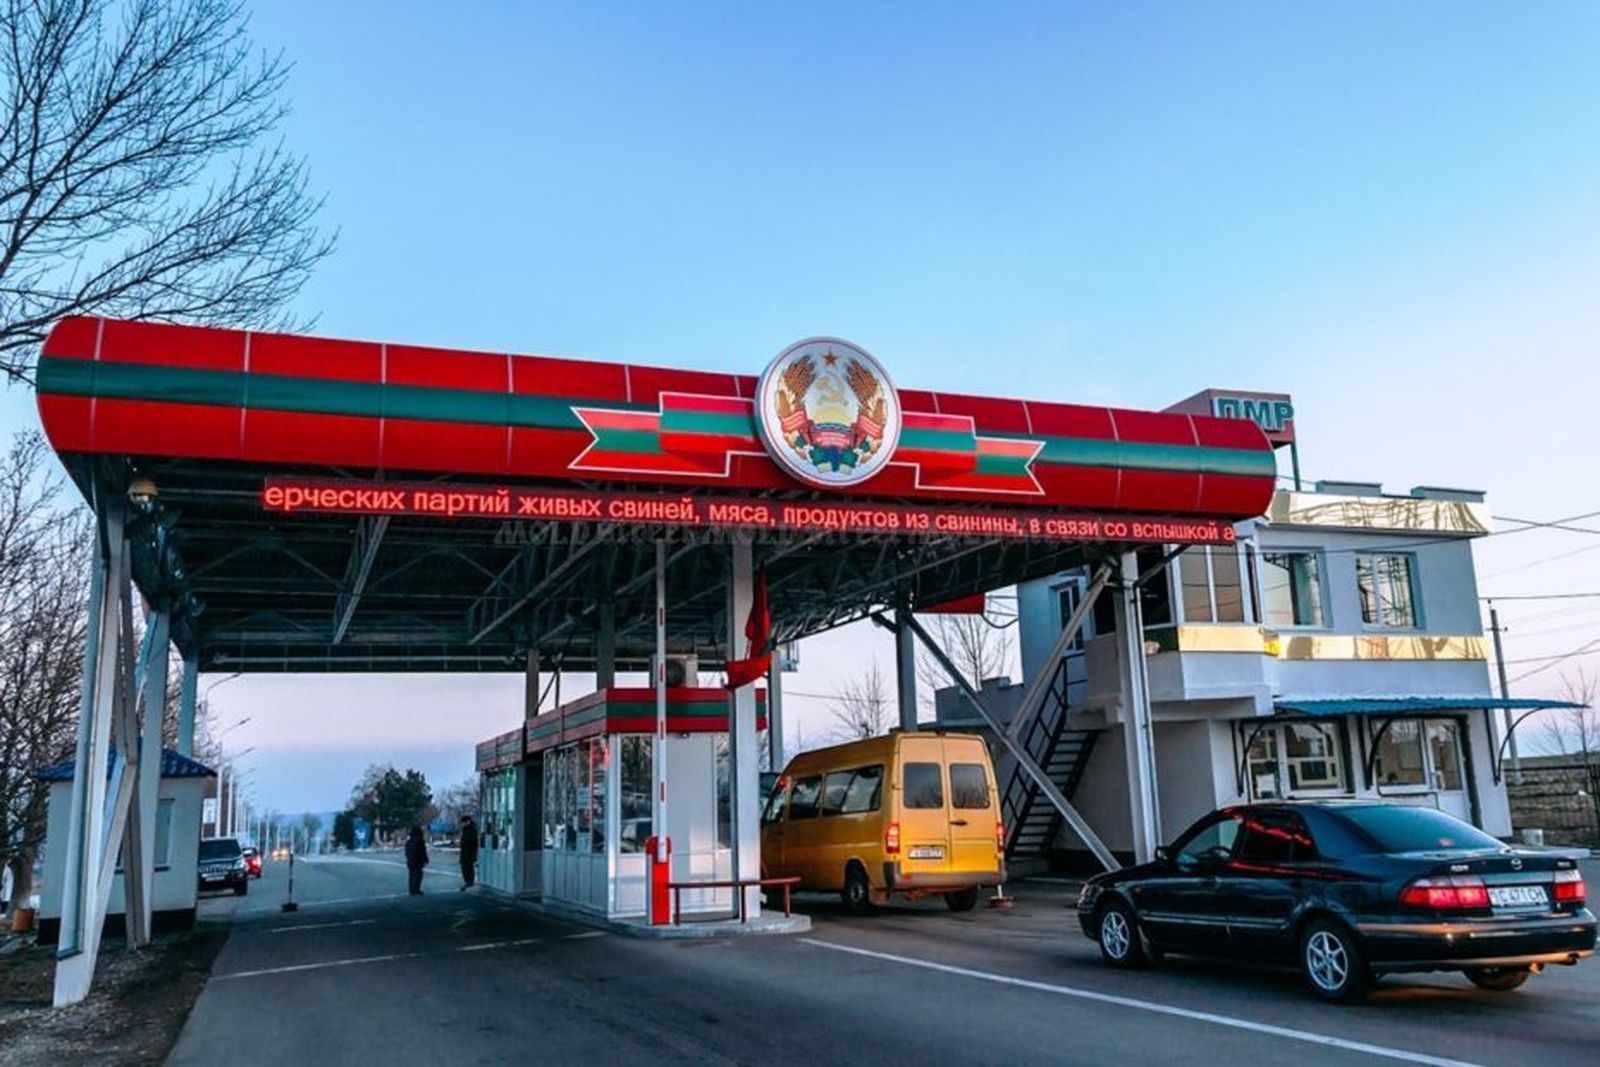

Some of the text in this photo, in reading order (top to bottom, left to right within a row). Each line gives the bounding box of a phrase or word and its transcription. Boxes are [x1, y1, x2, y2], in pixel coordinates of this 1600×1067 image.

[1214, 397, 1294, 431] ПМР
[264, 486, 405, 511] ерческих
[413, 487, 510, 514] партий
[517, 497, 602, 517] живых
[608, 497, 701, 524] свиней,
[708, 503, 777, 526] мяса,
[783, 506, 903, 530] продуктов
[905, 512, 930, 530] из
[934, 513, 1024, 538] свинины,
[1029, 518, 1041, 534] в
[1044, 519, 1100, 537] связи
[1103, 521, 1128, 537] со
[1131, 520, 1219, 540] вспышкой
